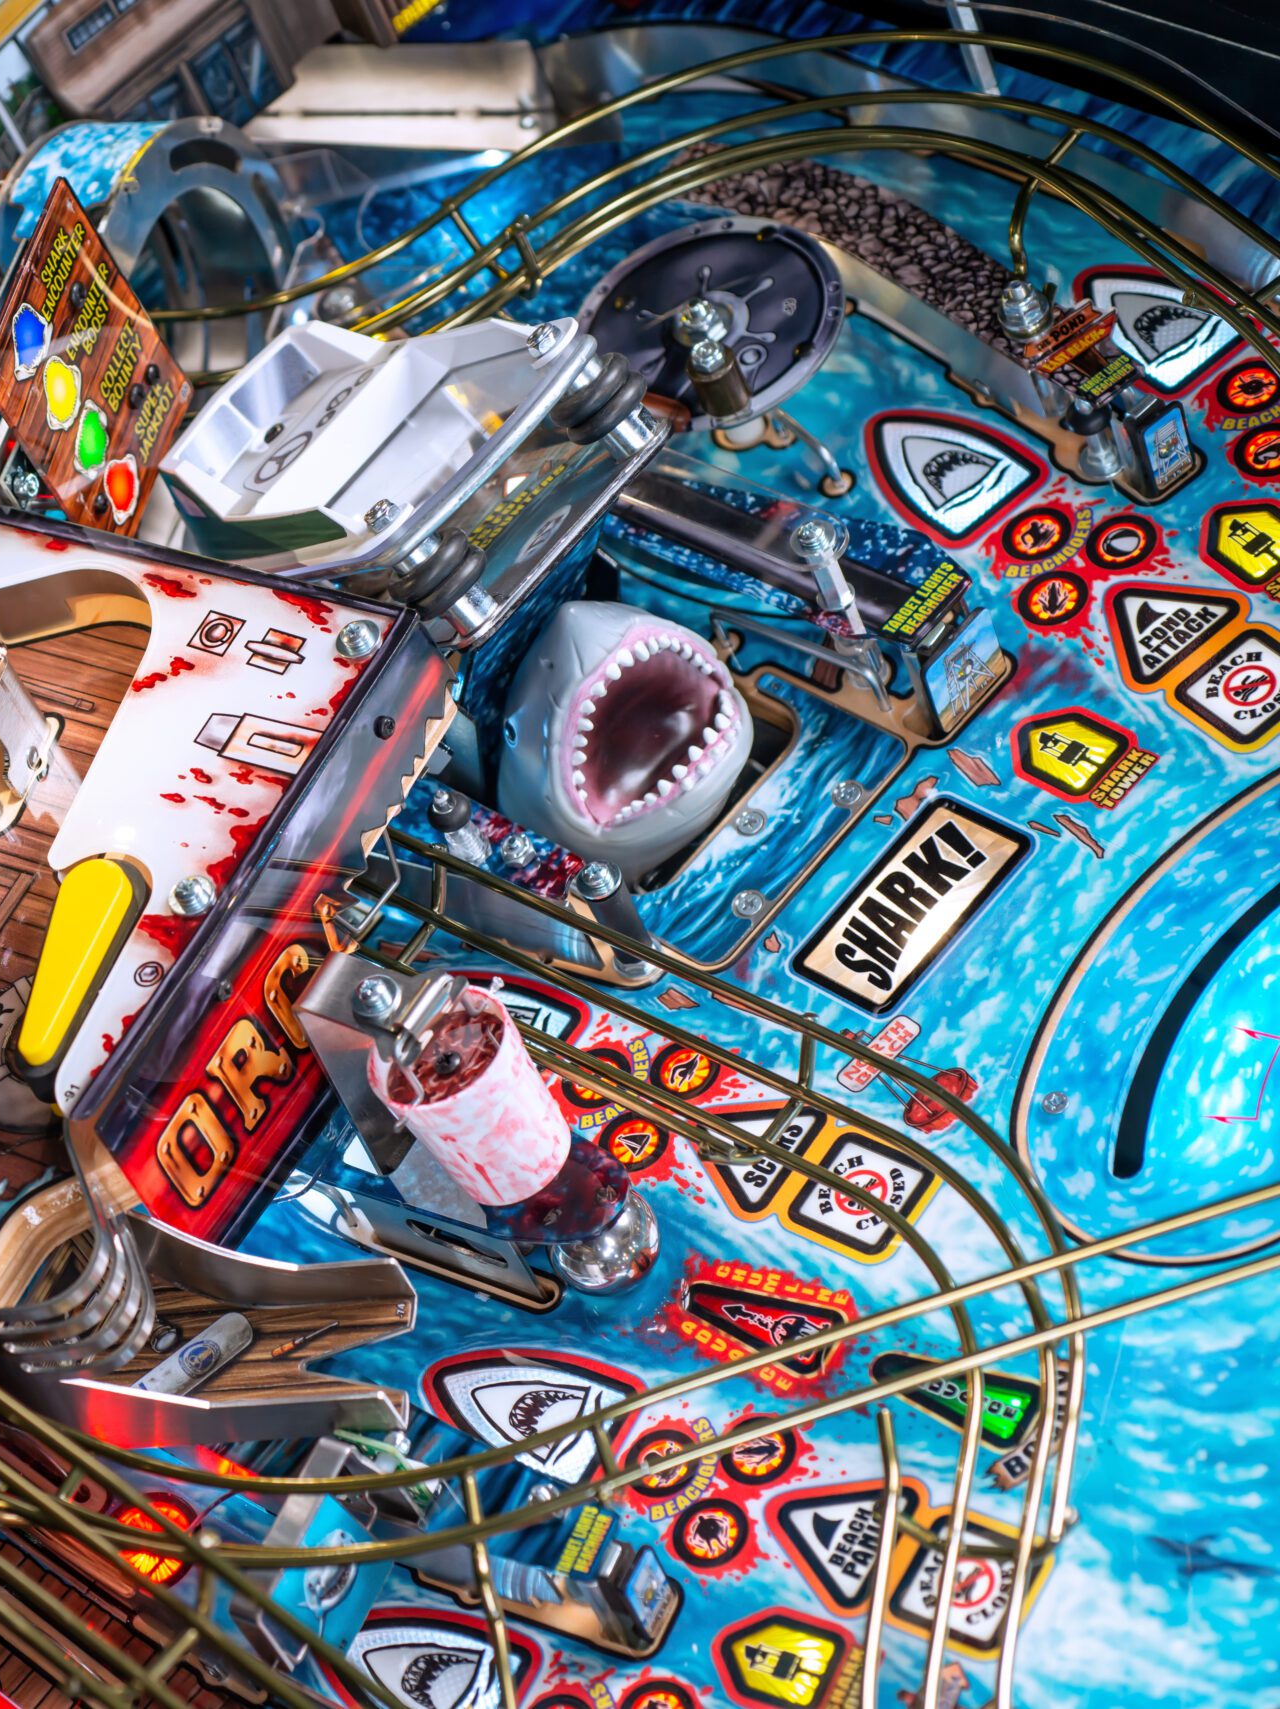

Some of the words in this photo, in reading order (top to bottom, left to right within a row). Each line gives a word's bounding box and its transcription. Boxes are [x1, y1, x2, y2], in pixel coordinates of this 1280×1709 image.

[41, 228, 68, 288] SHARK
[42, 224, 86, 322] ENCOUNTER
[83, 297, 109, 355] BOOST
[1042, 352, 1070, 372] EAST
[1067, 331, 1099, 358] BEACH
[1050, 314, 1086, 341] POND
[100, 319, 133, 398] COLLECT
[108, 333, 142, 413] BOUNTY
[1080, 371, 1106, 392] TARGET
[1105, 354, 1130, 376] LIGHTS
[1090, 363, 1135, 396] BEACHGOER
[140, 383, 173, 465] JACKPOT
[1222, 401, 1280, 430] BEACH
[1005, 508, 1092, 577] BEACHGOERS
[882, 596, 922, 633] TARGET
[916, 562, 954, 597] LIGHTS
[900, 572, 964, 635] BEACHGOER
[1139, 607, 1191, 650] POND
[1142, 606, 1219, 670] ATTACK
[1206, 651, 1263, 699] BEACH
[1090, 749, 1144, 802] SHARK
[1100, 754, 1156, 807] TOWER
[834, 820, 988, 991] SHARK!
[156, 893, 360, 1208] ORC
[854, 1029, 914, 1086] BECH
[63, 1083, 81, 1102] -91
[580, 1039, 649, 1129] BEAOERS
[818, 1155, 865, 1216] BECH
[856, 1167, 906, 1230] CLSED
[716, 1265, 781, 1293] CHUM
[784, 1282, 850, 1305] LINE
[680, 1321, 794, 1391] ADVACE
[650, 1418, 716, 1521] BEACHGORS
[555, 1538, 582, 1577] TARGET
[572, 1505, 599, 1539] LIGHTS
[574, 1514, 613, 1574] BEACHGOER
[828, 1508, 873, 1567] BEACH
[965, 1561, 1016, 1625] CLOSE
